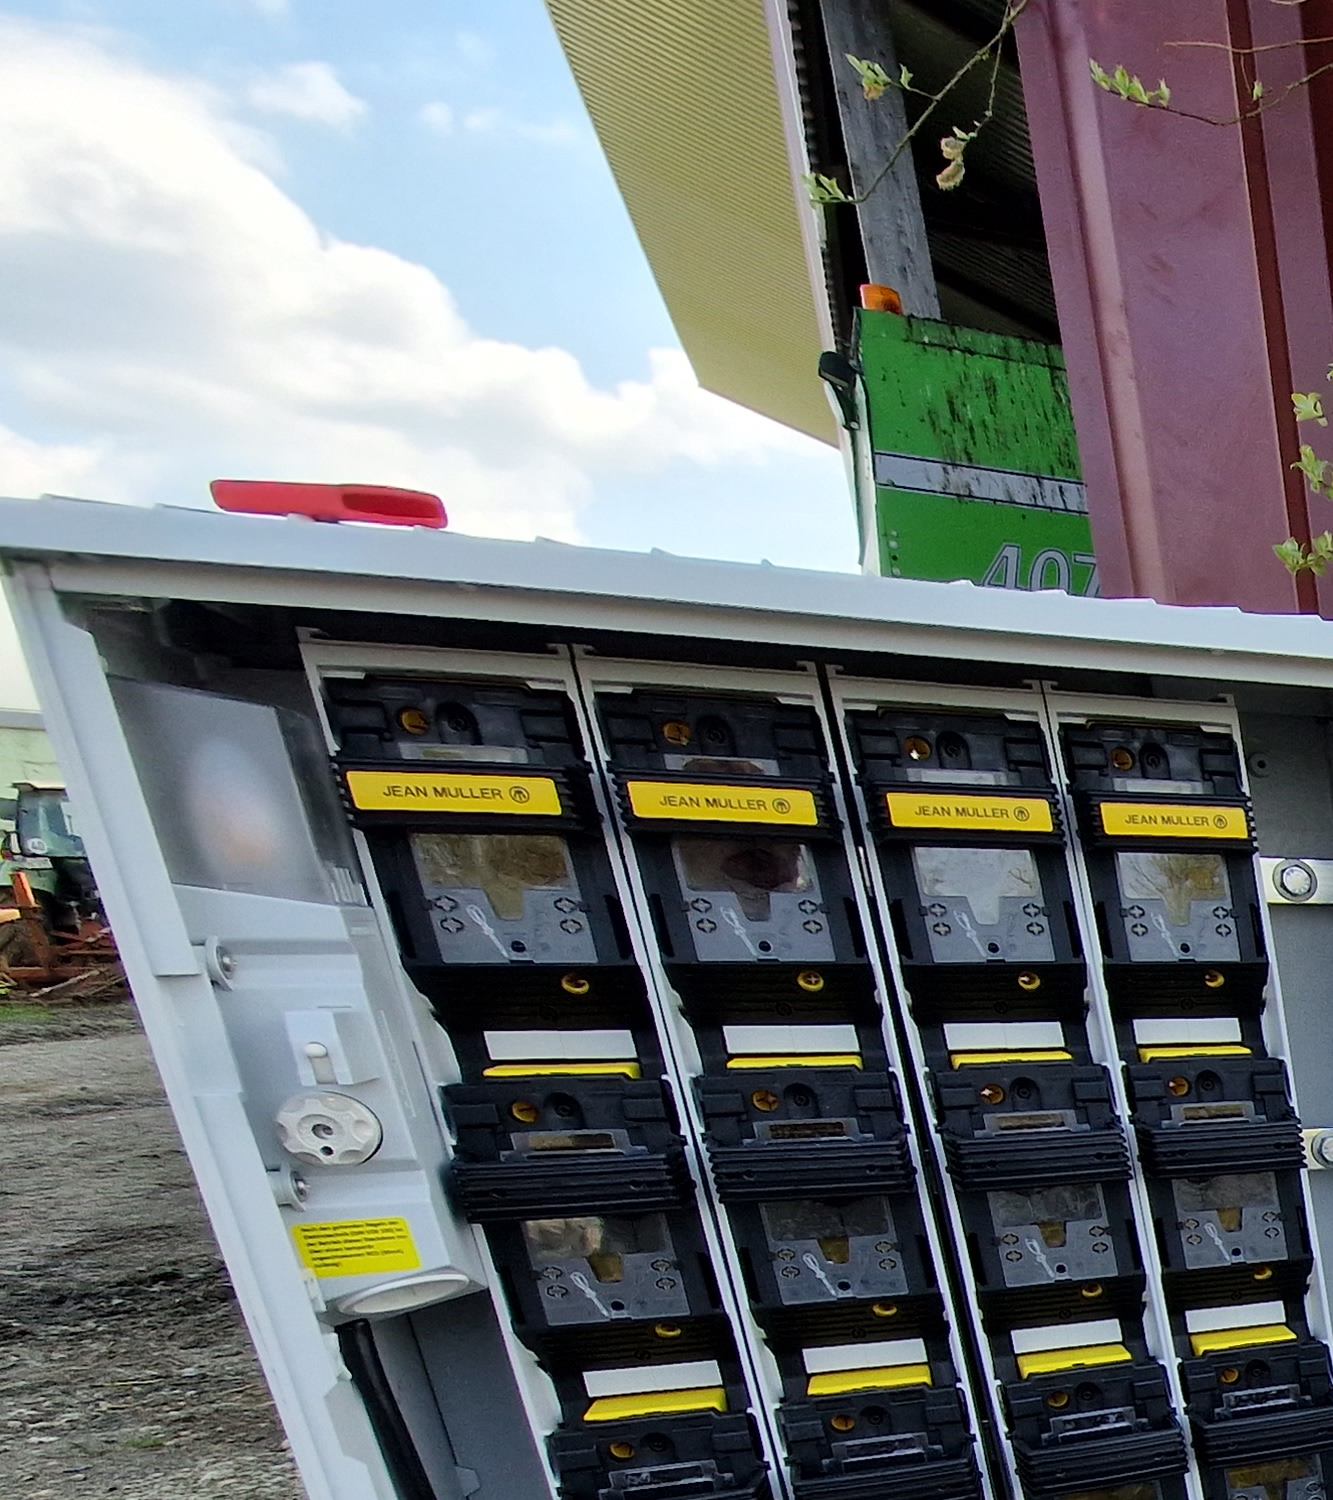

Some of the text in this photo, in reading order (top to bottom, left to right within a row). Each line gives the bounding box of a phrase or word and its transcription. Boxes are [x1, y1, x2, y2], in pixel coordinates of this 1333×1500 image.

[383, 785, 503, 800] JEAN MULLER
[659, 795, 768, 811] JEAN MULLER
[915, 805, 1010, 819] JEAN MULLER
[1124, 814, 1210, 827] JEAN MULLER
